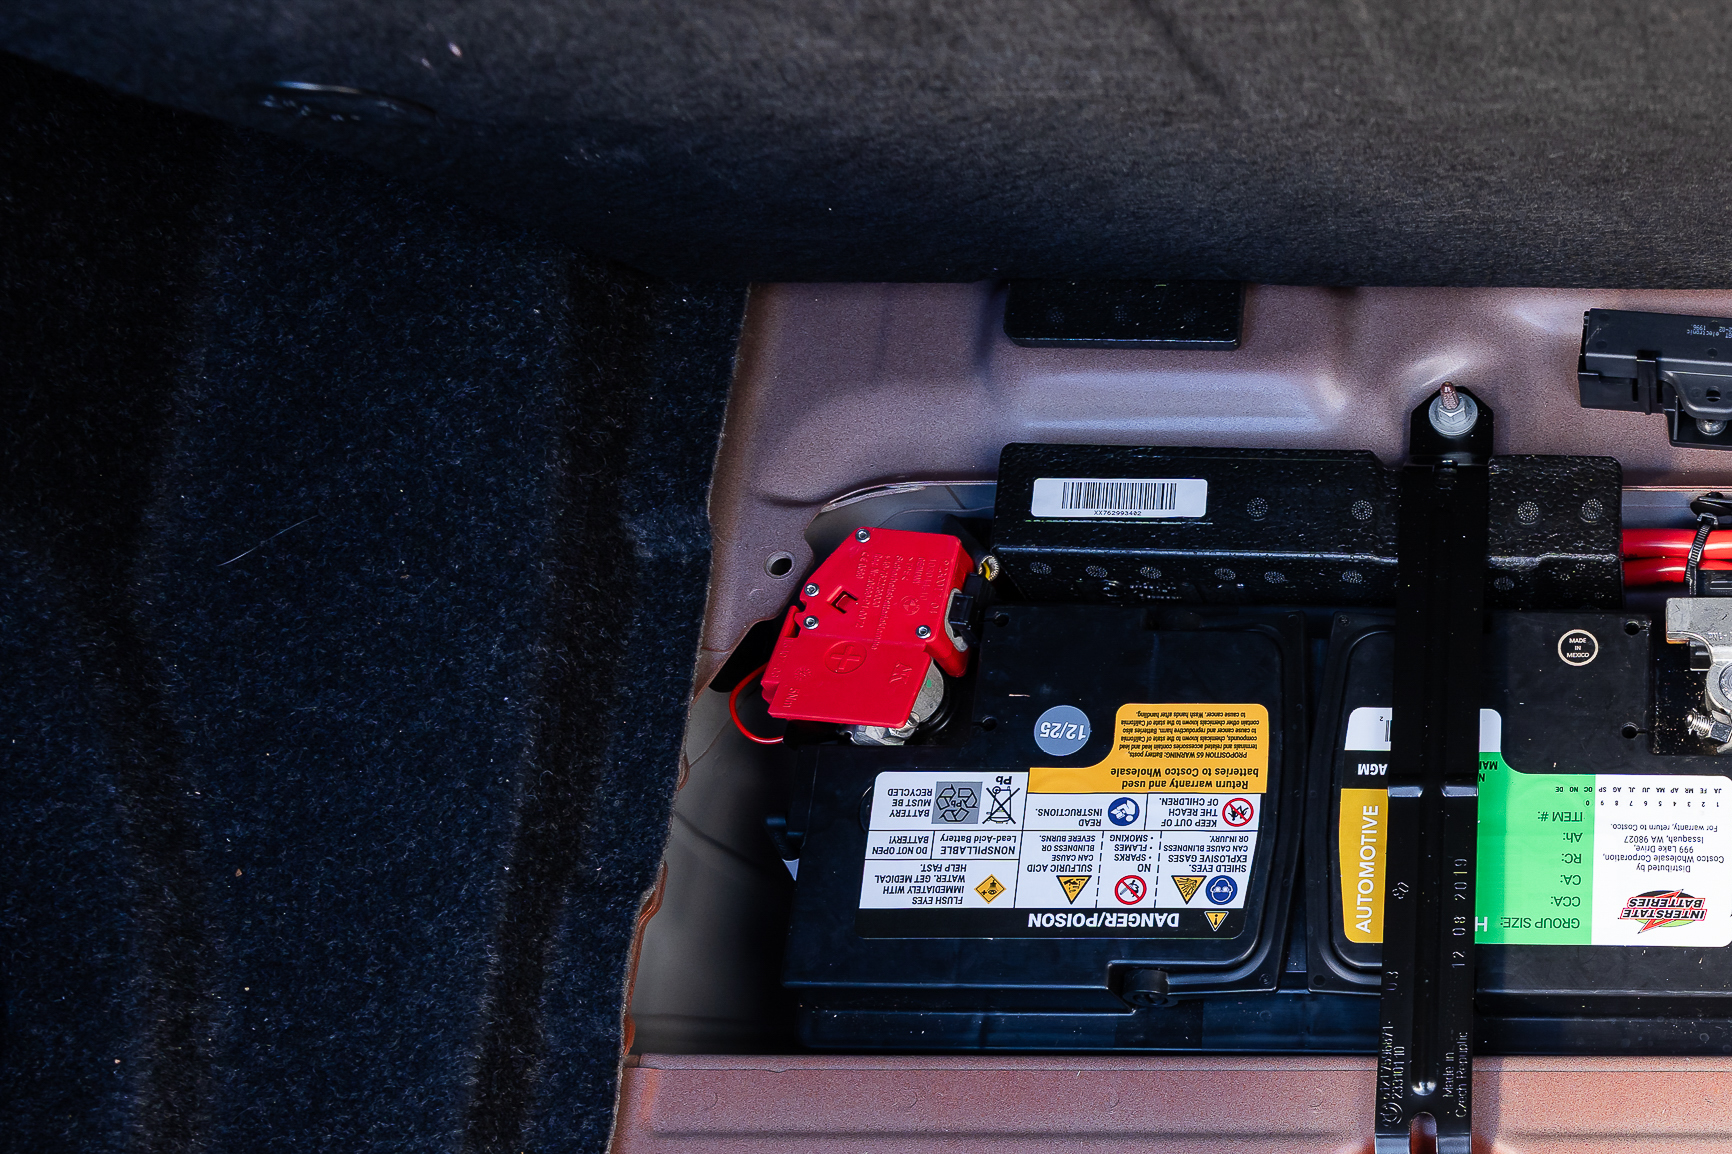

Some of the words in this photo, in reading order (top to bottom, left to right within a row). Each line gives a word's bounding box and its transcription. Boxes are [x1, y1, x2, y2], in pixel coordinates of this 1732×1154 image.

[1040, 721, 1087, 740] 12/25
[1111, 768, 1162, 777] Wholesale
[1165, 768, 1199, 777] Costco
[1202, 768, 1212, 776] to
[1214, 768, 1259, 777] batteries
[1358, 763, 1387, 775] AGM
[996, 776, 1012, 785] Pb
[1122, 780, 1146, 789] used
[1149, 780, 1167, 789] and
[1170, 778, 1213, 788] warranty
[1216, 780, 1248, 789] Return
[888, 788, 933, 796] RECYCLED
[951, 799, 962, 808] Pb
[1159, 797, 1205, 806] CHILDREN.
[1207, 798, 1219, 806] OF
[1169, 808, 1198, 816] REACH
[1200, 809, 1218, 817] THE
[1537, 811, 1549, 821] #:
[1552, 811, 1583, 822] ITEM
[1161, 819, 1173, 827] OF
[1195, 819, 1217, 827] KEEP
[1611, 823, 1638, 831] Costco.
[1672, 822, 1705, 831] warranty,
[1707, 824, 1718, 832] For
[889, 836, 929, 844] BATTERY!
[940, 834, 972, 843] Battery
[974, 835, 1017, 843] Lead-Acid
[1110, 834, 1148, 842] SMOKING
[1563, 832, 1583, 842] Ah:
[1624, 835, 1648, 843] 98027
[1666, 834, 1704, 843] Issaquah,
[872, 846, 895, 854] OPEN
[941, 846, 1015, 854] NONSPILLABLE
[1634, 844, 1656, 853] Drive,
[1657, 845, 1677, 853] Lake
[1679, 845, 1694, 853] 999
[1561, 853, 1581, 864] RC:
[1603, 853, 1651, 862] Corporation,
[1654, 855, 1694, 863] Wholesale
[1697, 855, 1724, 863] Costco
[920, 864, 943, 872] FAST.
[945, 864, 967, 872] HELP
[1027, 864, 1048, 872] ACID
[1050, 864, 1093, 872] SULFURIC
[1137, 864, 1151, 872] NO
[1189, 864, 1213, 872] EYES.
[1216, 864, 1247, 872] SHIELD
[1356, 805, 1379, 934] AUTOMOTIVE
[1636, 863, 1646, 872] by
[1647, 864, 1691, 873] Distributed
[875, 875, 913, 883] MEDICAL
[914, 875, 931, 883] GET
[934, 875, 966, 883] WATER.
[1452, 857, 1468, 901] 2019
[1560, 874, 1581, 885] CA:
[883, 886, 905, 894] WITH
[907, 886, 964, 894] IMMEDIATELY
[912, 896, 934, 904] EYES
[1551, 896, 1581, 907] CCA:
[1629, 898, 1704, 908] BATTERIES
[1622, 909, 1706, 919] INTERSTATE
[1028, 912, 1179, 927] DANGER/POISON
[1500, 917, 1532, 928] SIZE:
[1535, 917, 1580, 929] GROUP
[1451, 915, 1467, 937] 08
[1451, 950, 1466, 969] 12
[1443, 1052, 1455, 1062] in
[1442, 1066, 1455, 1098] Made
[1455, 1083, 1468, 1118] Czech
